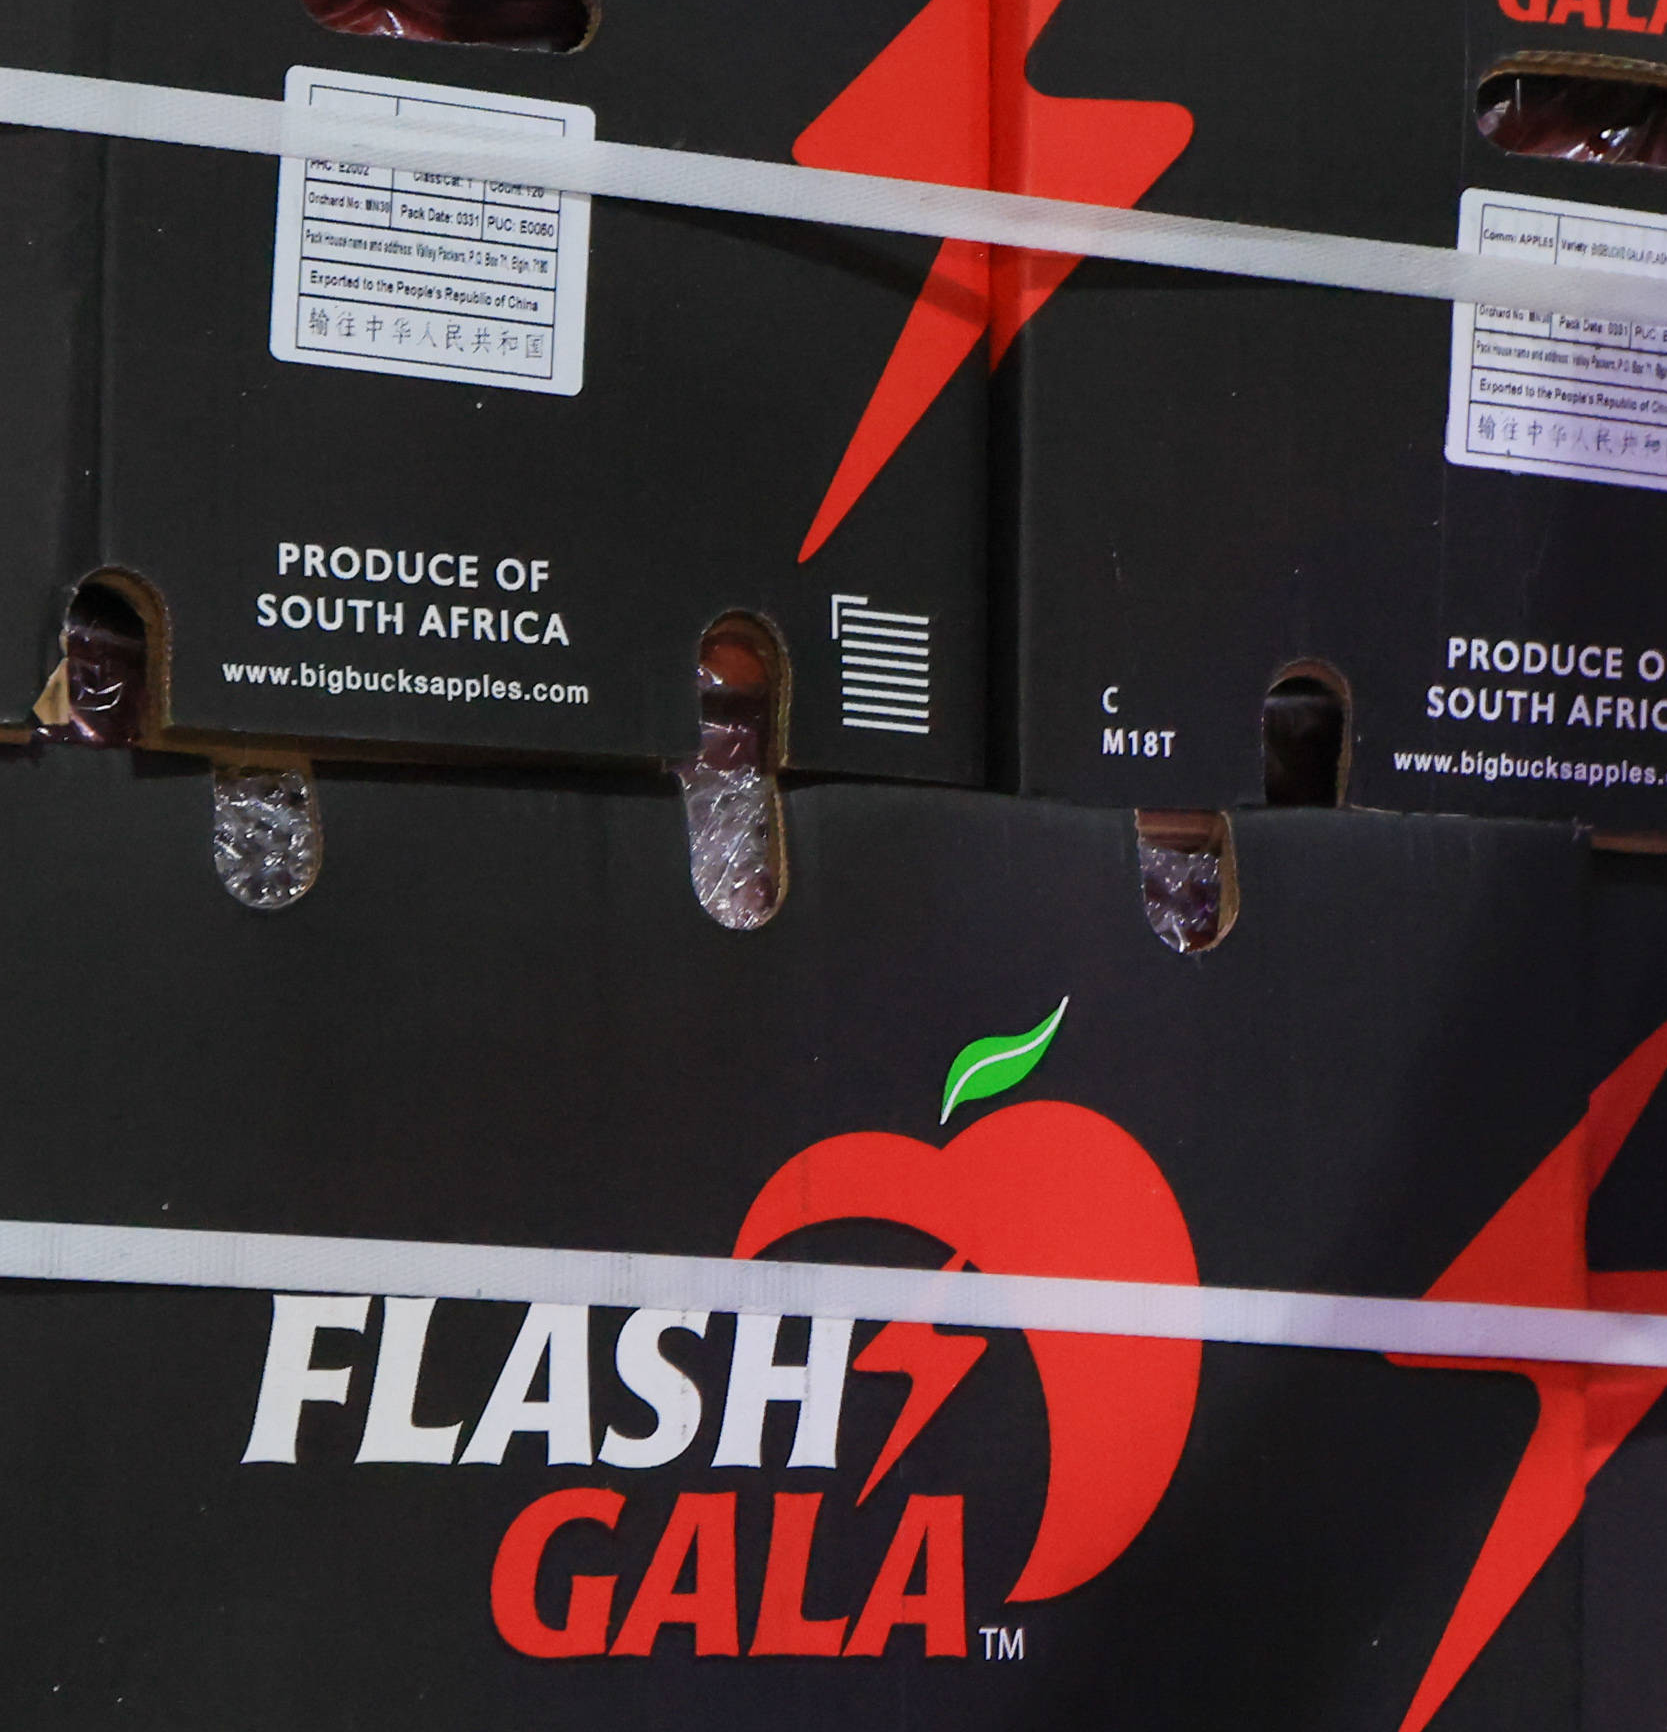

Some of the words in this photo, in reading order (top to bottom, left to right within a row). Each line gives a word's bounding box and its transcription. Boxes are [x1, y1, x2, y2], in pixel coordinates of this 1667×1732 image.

[400, 204, 424, 221] Pack
[428, 207, 453, 224] Date:
[1519, 233, 1554, 248] APPLES
[310, 269, 360, 288] Exported
[362, 277, 374, 291] to
[376, 279, 394, 293] the
[396, 281, 442, 300] People's
[445, 287, 492, 306] Republic
[494, 295, 506, 308] of
[508, 295, 538, 312] China
[1480, 378, 1523, 397] Exported
[1525, 383, 1535, 397] to
[1537, 385, 1553, 400] the
[1554, 387, 1594, 406] People's
[1596, 393, 1638, 412] Republic
[1639, 399, 1649, 412] of
[278, 542, 479, 588] PRODUCE
[495, 557, 549, 593] OF
[256, 592, 404, 635] SOUTH
[418, 604, 571, 646] AFRICA
[1447, 637, 1623, 682] PRODUCE
[222, 662, 590, 704] www.bigbucksapples.com
[1102, 686, 1119, 713] C
[1426, 686, 1555, 726] SOUTH
[1102, 729, 1176, 758] M18T
[240, 1294, 854, 1469] FLASH
[489, 1486, 968, 1659] GALA
[978, 1626, 1025, 1662] TM
